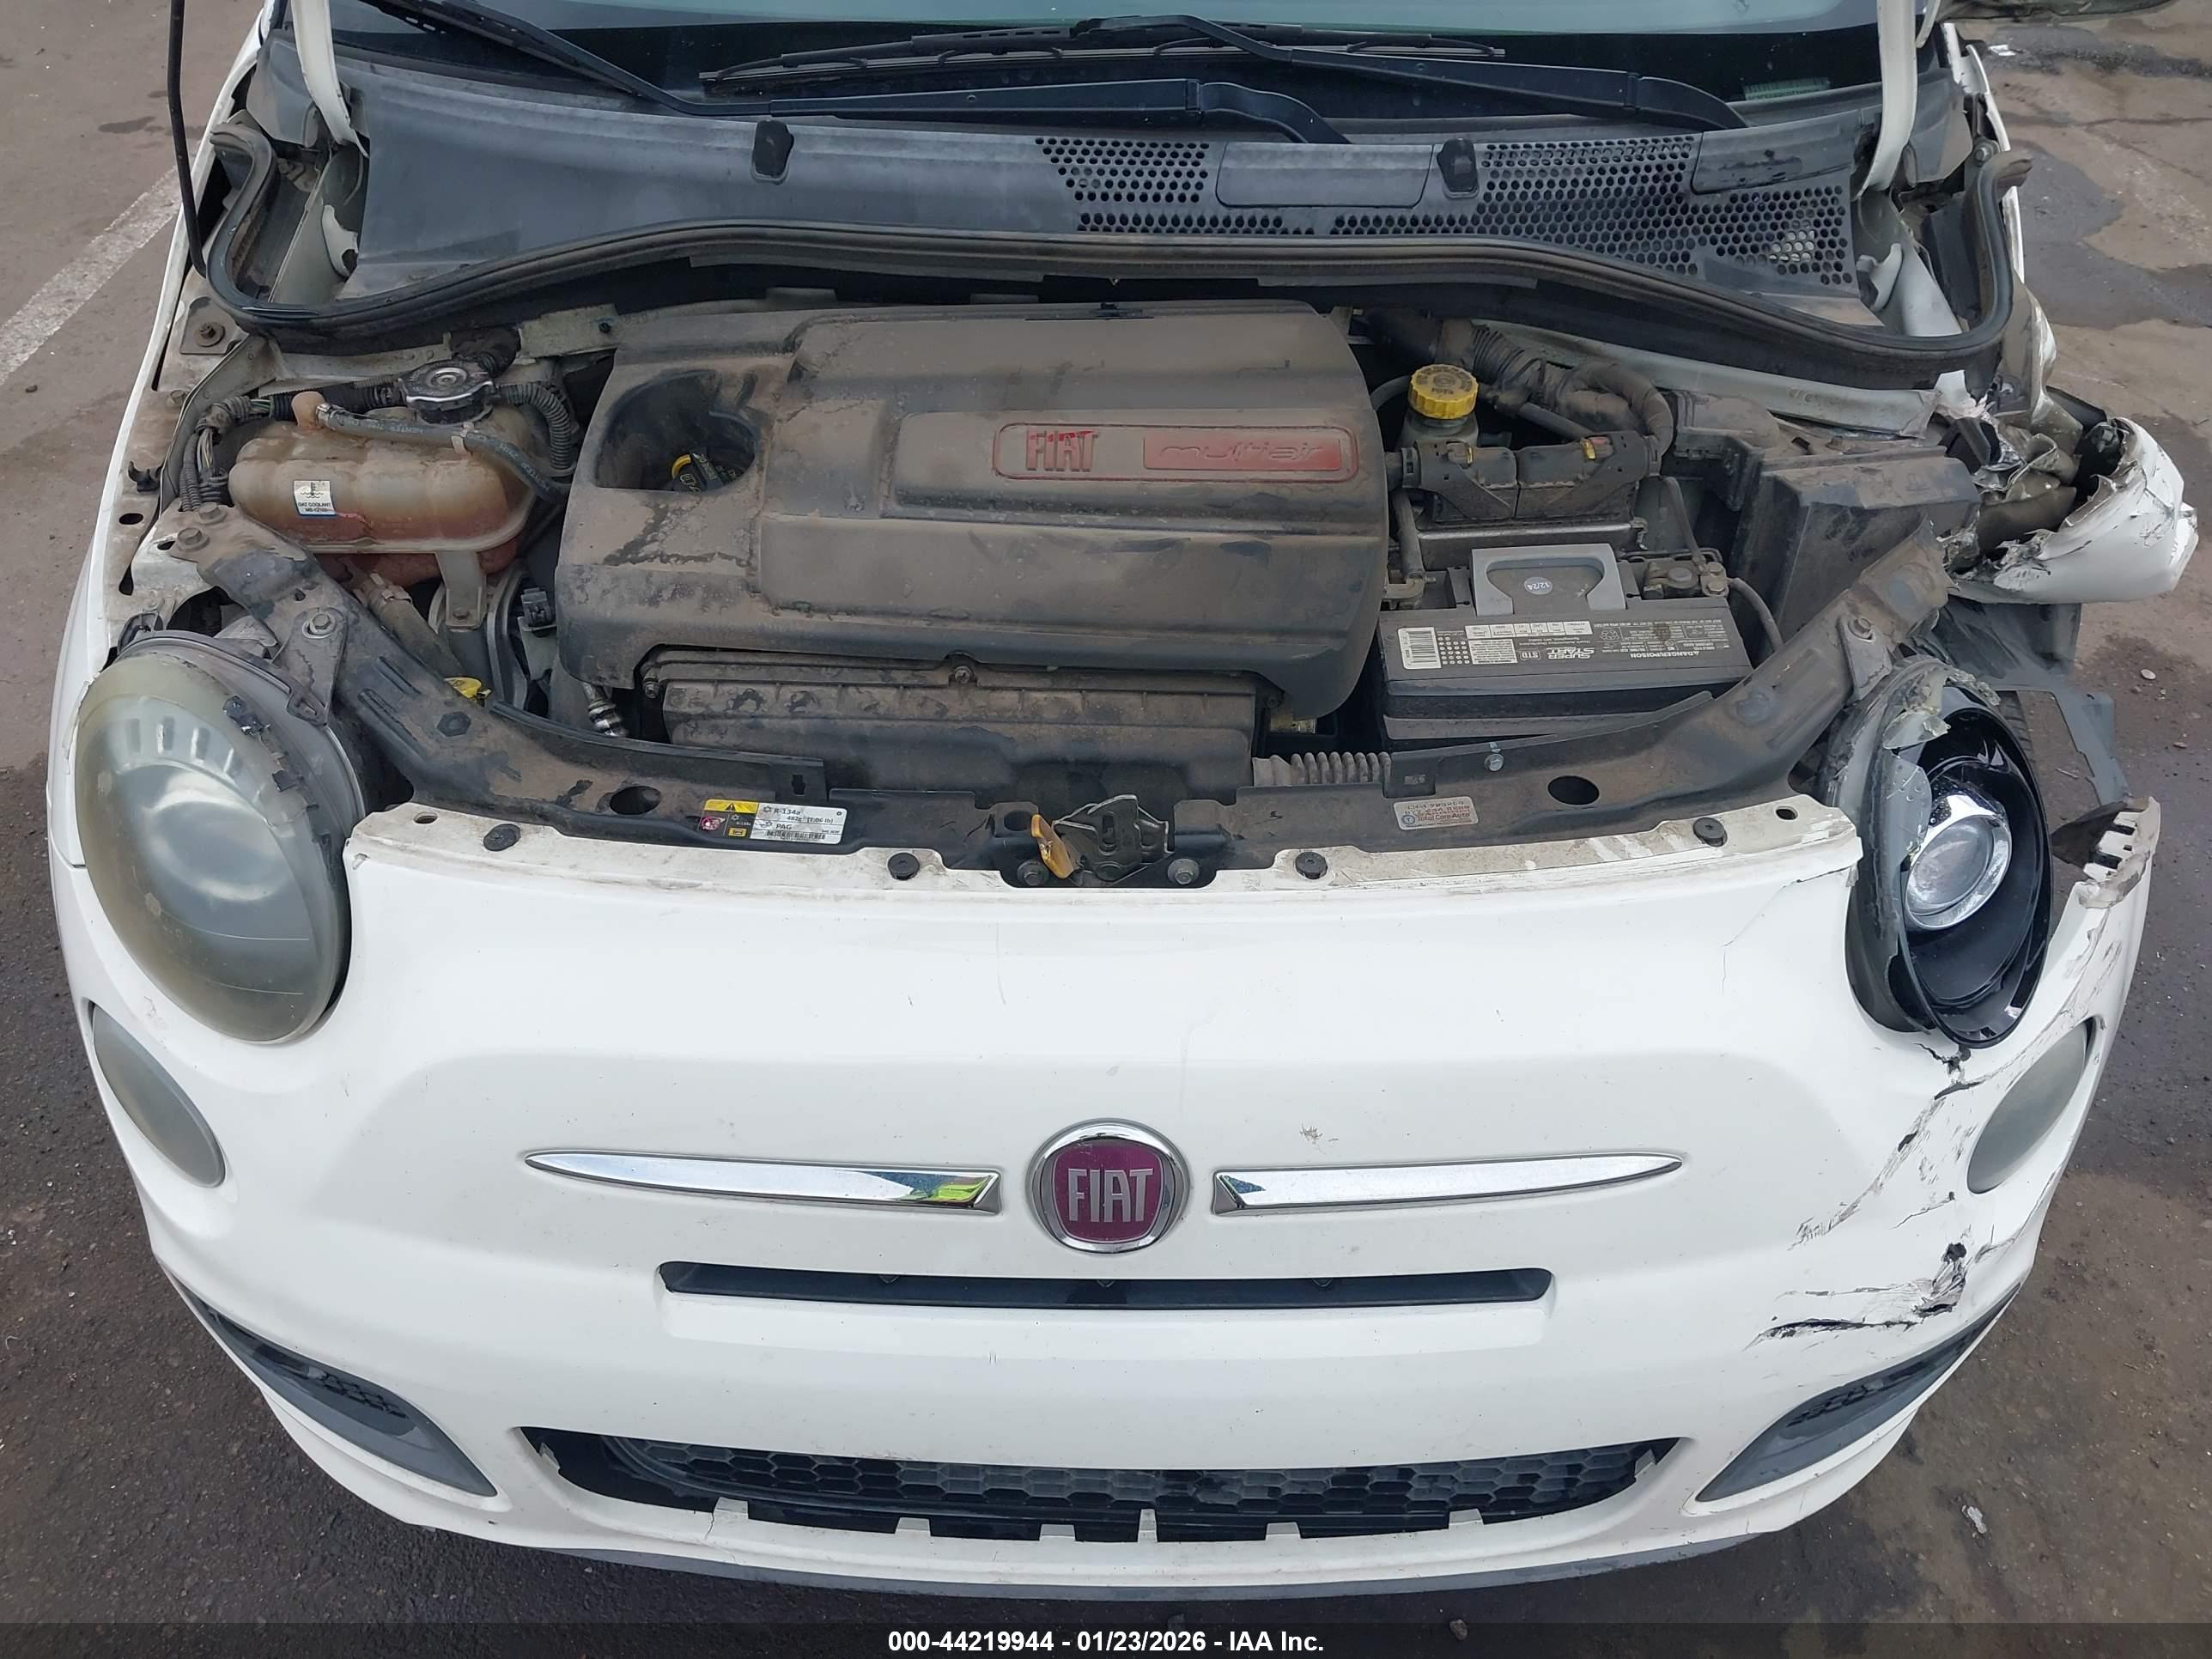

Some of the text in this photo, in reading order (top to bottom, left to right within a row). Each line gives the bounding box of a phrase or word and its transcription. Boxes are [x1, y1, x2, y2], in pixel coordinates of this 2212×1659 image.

[1026, 430, 1101, 471] FIAT
[1547, 647, 1595, 655] START
[1067, 1168, 1154, 1223] FIAT
